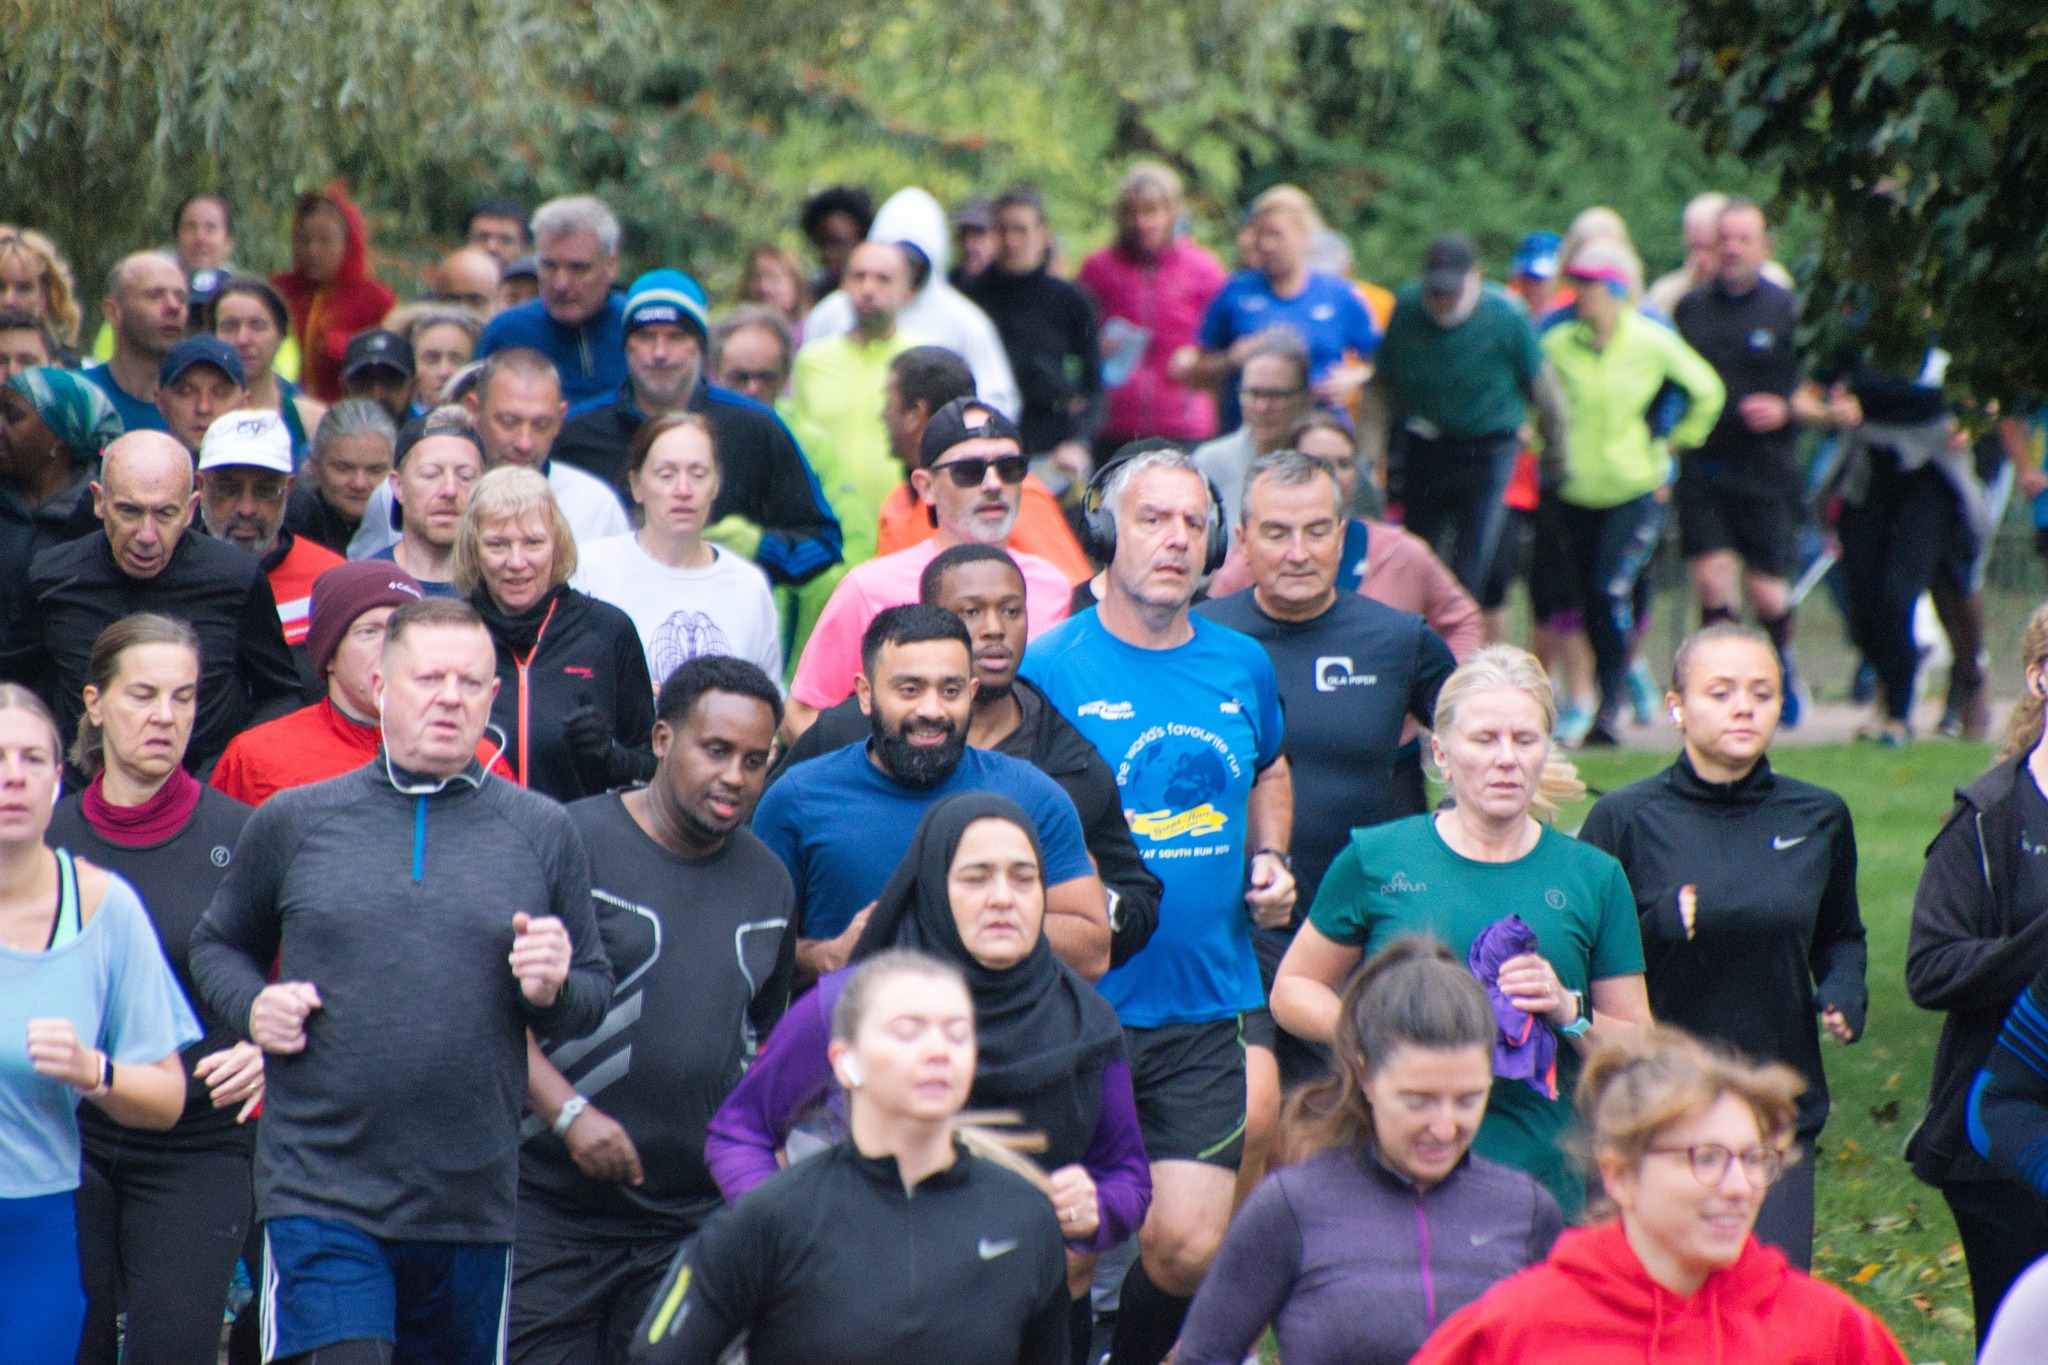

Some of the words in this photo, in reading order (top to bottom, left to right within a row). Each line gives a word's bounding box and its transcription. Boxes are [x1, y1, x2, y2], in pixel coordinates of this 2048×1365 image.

[1327, 676, 1347, 686] DLA
[1348, 675, 1378, 686] PIPER
[1167, 721, 1229, 754] favourite
[1226, 753, 1241, 779] run
[1158, 847, 1192, 858] SOUTH
[1194, 846, 1213, 857] RUN
[1380, 870, 1427, 896] parkrun
